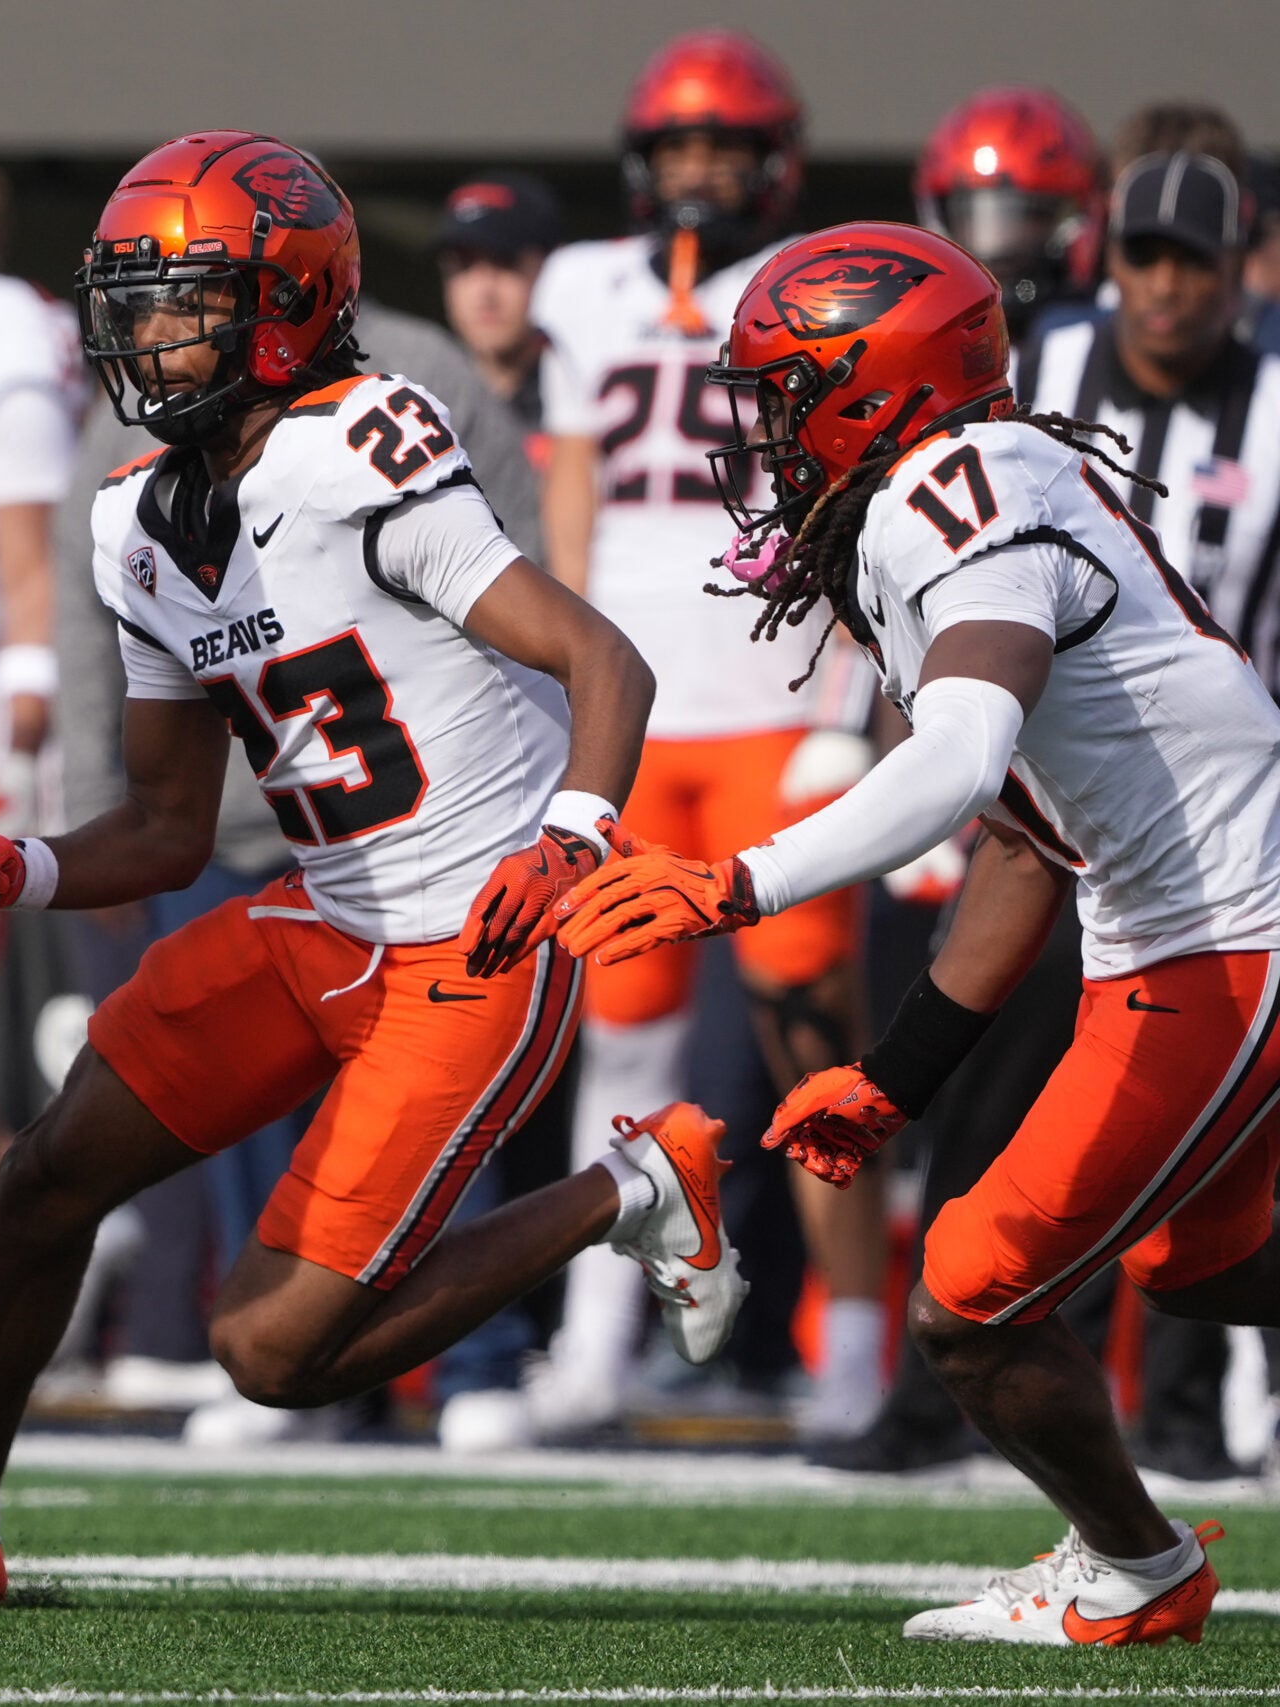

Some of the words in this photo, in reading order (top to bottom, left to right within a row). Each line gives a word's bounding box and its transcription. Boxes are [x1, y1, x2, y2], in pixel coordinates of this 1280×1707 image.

[113, 242, 135, 254] OSU
[188, 241, 223, 255] BEAVS
[346, 386, 456, 490] 23
[591, 360, 756, 504] 25
[905, 443, 1001, 555] 17
[189, 607, 285, 672] BEAVS
[197, 626, 431, 847] 23
